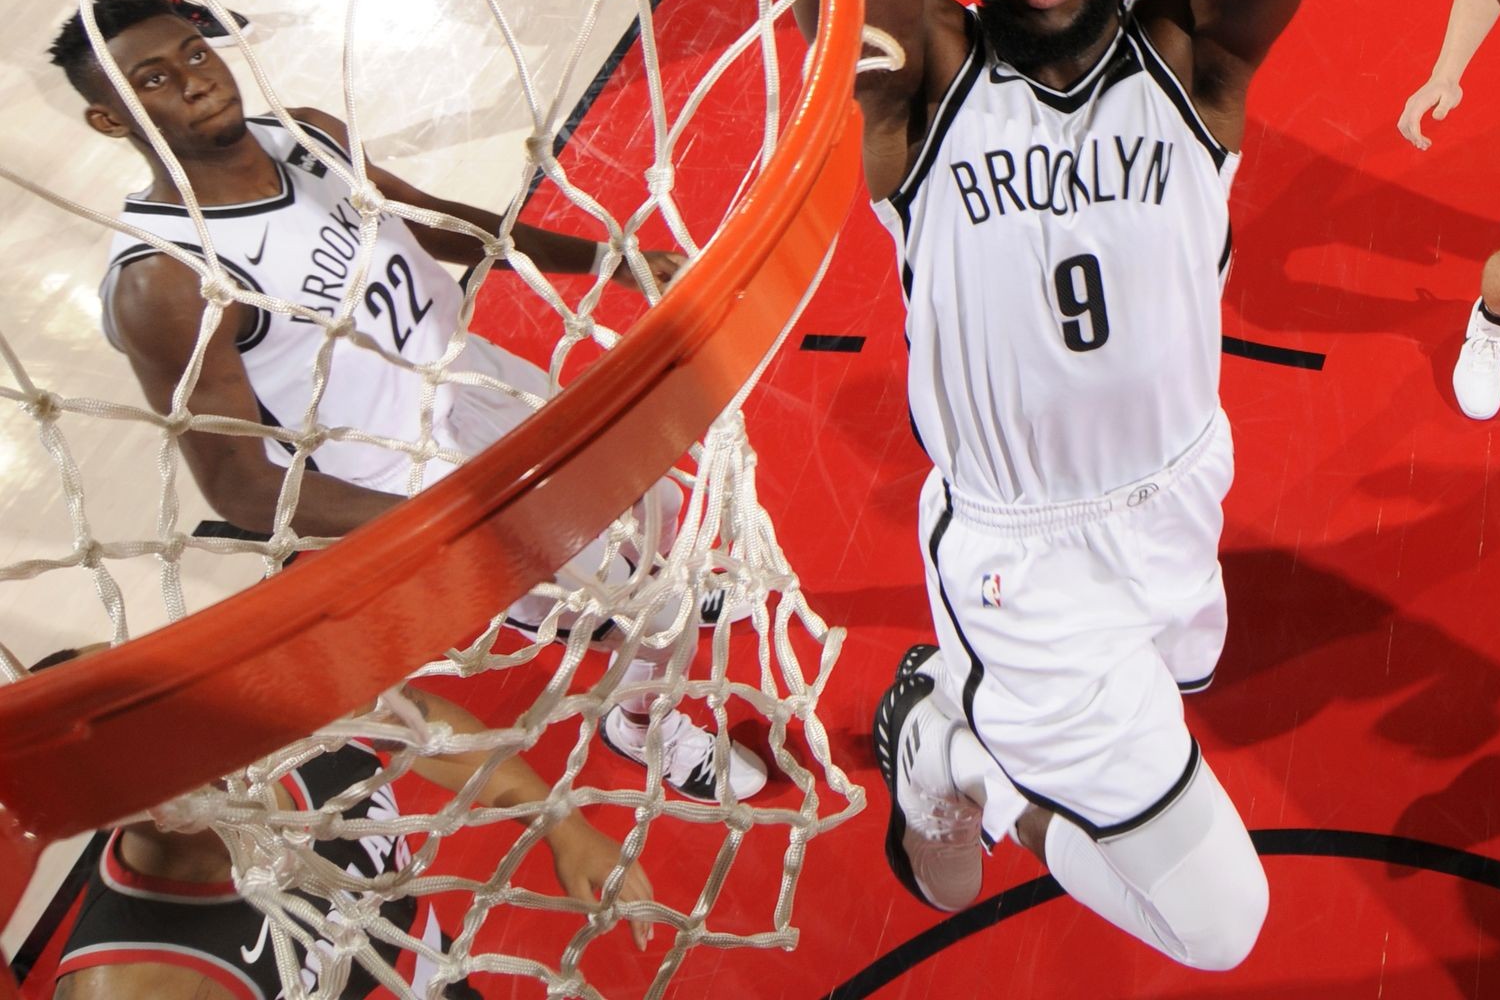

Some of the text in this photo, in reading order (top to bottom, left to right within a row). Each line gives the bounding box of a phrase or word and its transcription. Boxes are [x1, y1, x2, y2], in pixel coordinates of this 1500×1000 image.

[950, 135, 1173, 225] BROOKLYN
[365, 254, 433, 352] 22
[1054, 253, 1109, 352] 9
